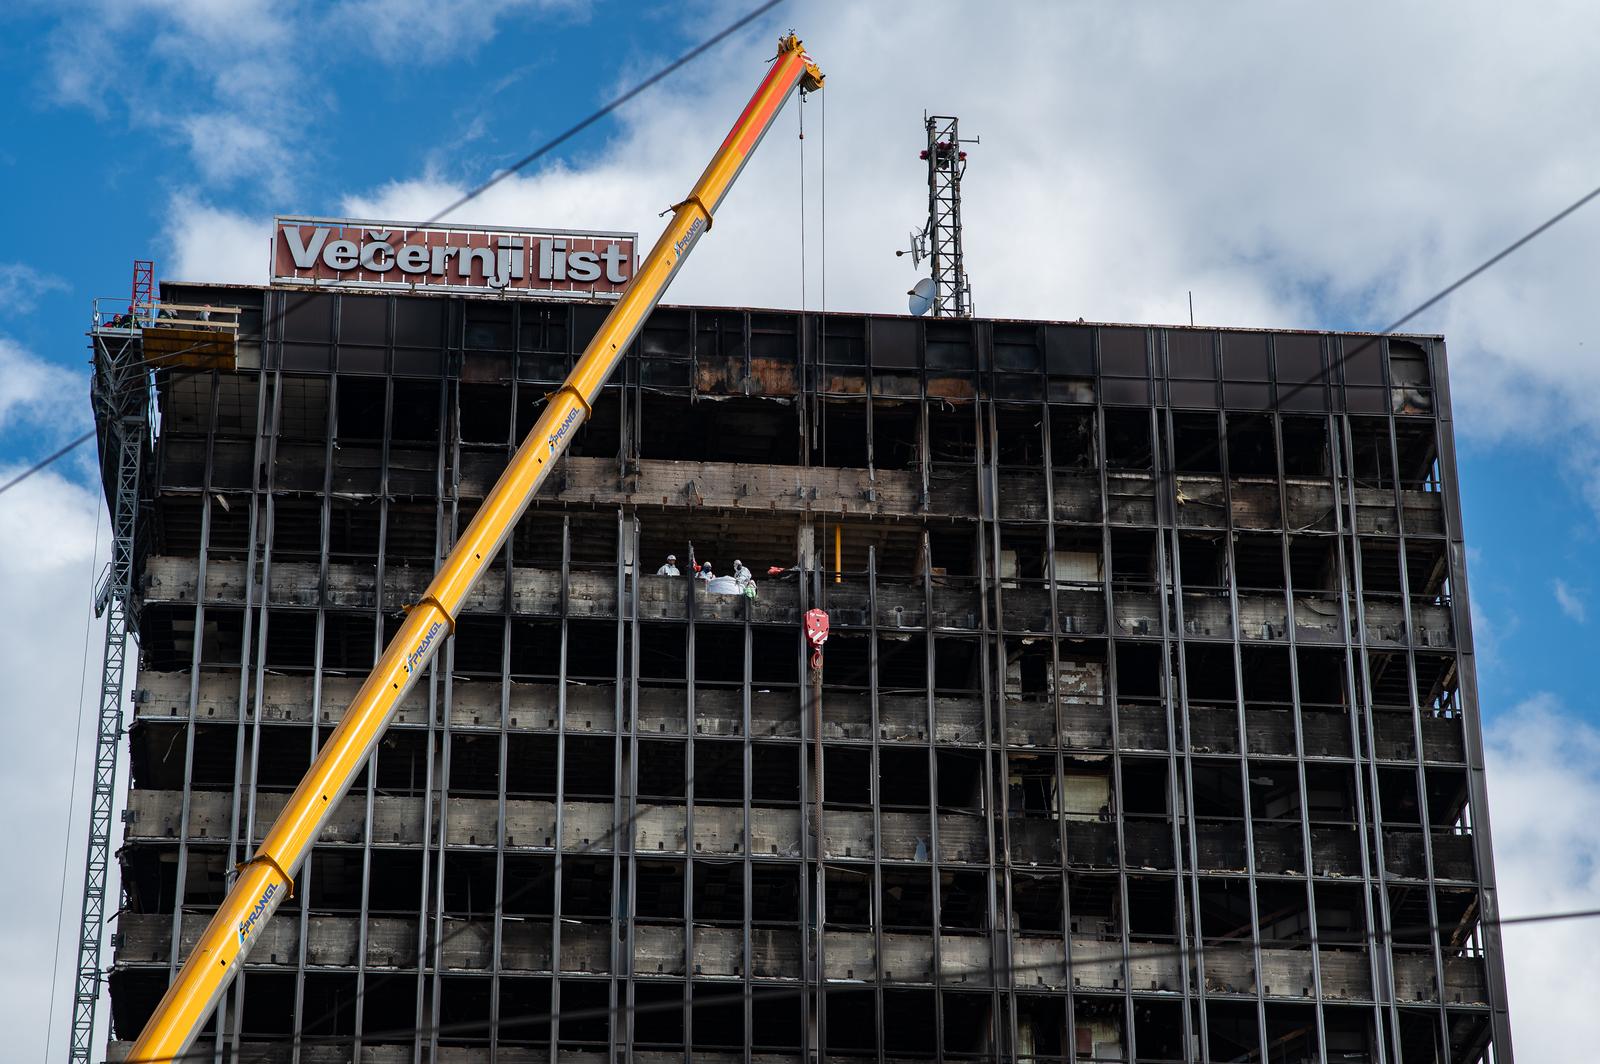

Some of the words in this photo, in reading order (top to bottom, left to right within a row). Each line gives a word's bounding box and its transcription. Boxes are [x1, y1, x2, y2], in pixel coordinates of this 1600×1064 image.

[678, 216, 703, 250] PRANGL
[283, 226, 524, 289] Večernji
[538, 238, 628, 283] list
[552, 407, 580, 445] PRANGL
[410, 621, 442, 664] PRANGL
[243, 883, 279, 934] PRANGL
